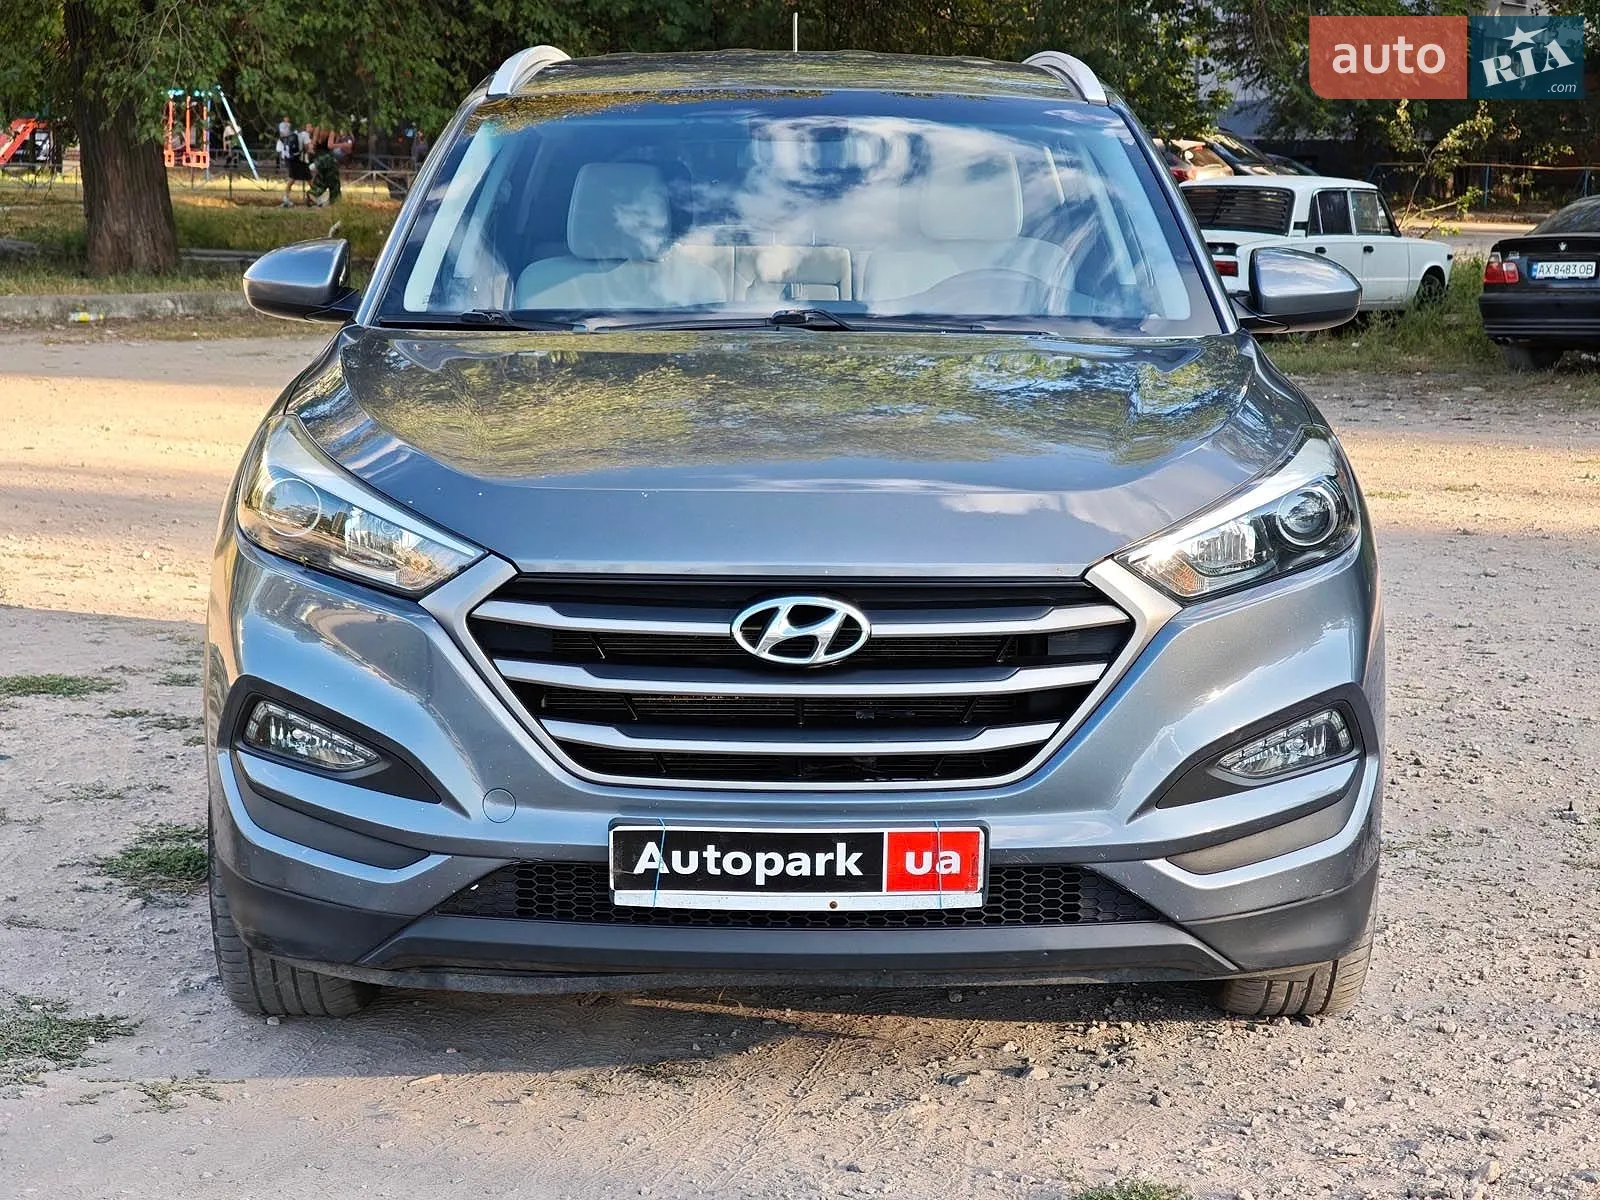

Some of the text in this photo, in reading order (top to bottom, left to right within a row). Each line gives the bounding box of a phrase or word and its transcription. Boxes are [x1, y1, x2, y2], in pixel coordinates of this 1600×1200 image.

[1538, 263, 1552, 275] AX
[1553, 263, 1578, 275] 8483
[633, 841, 962, 886] Autopark ua
